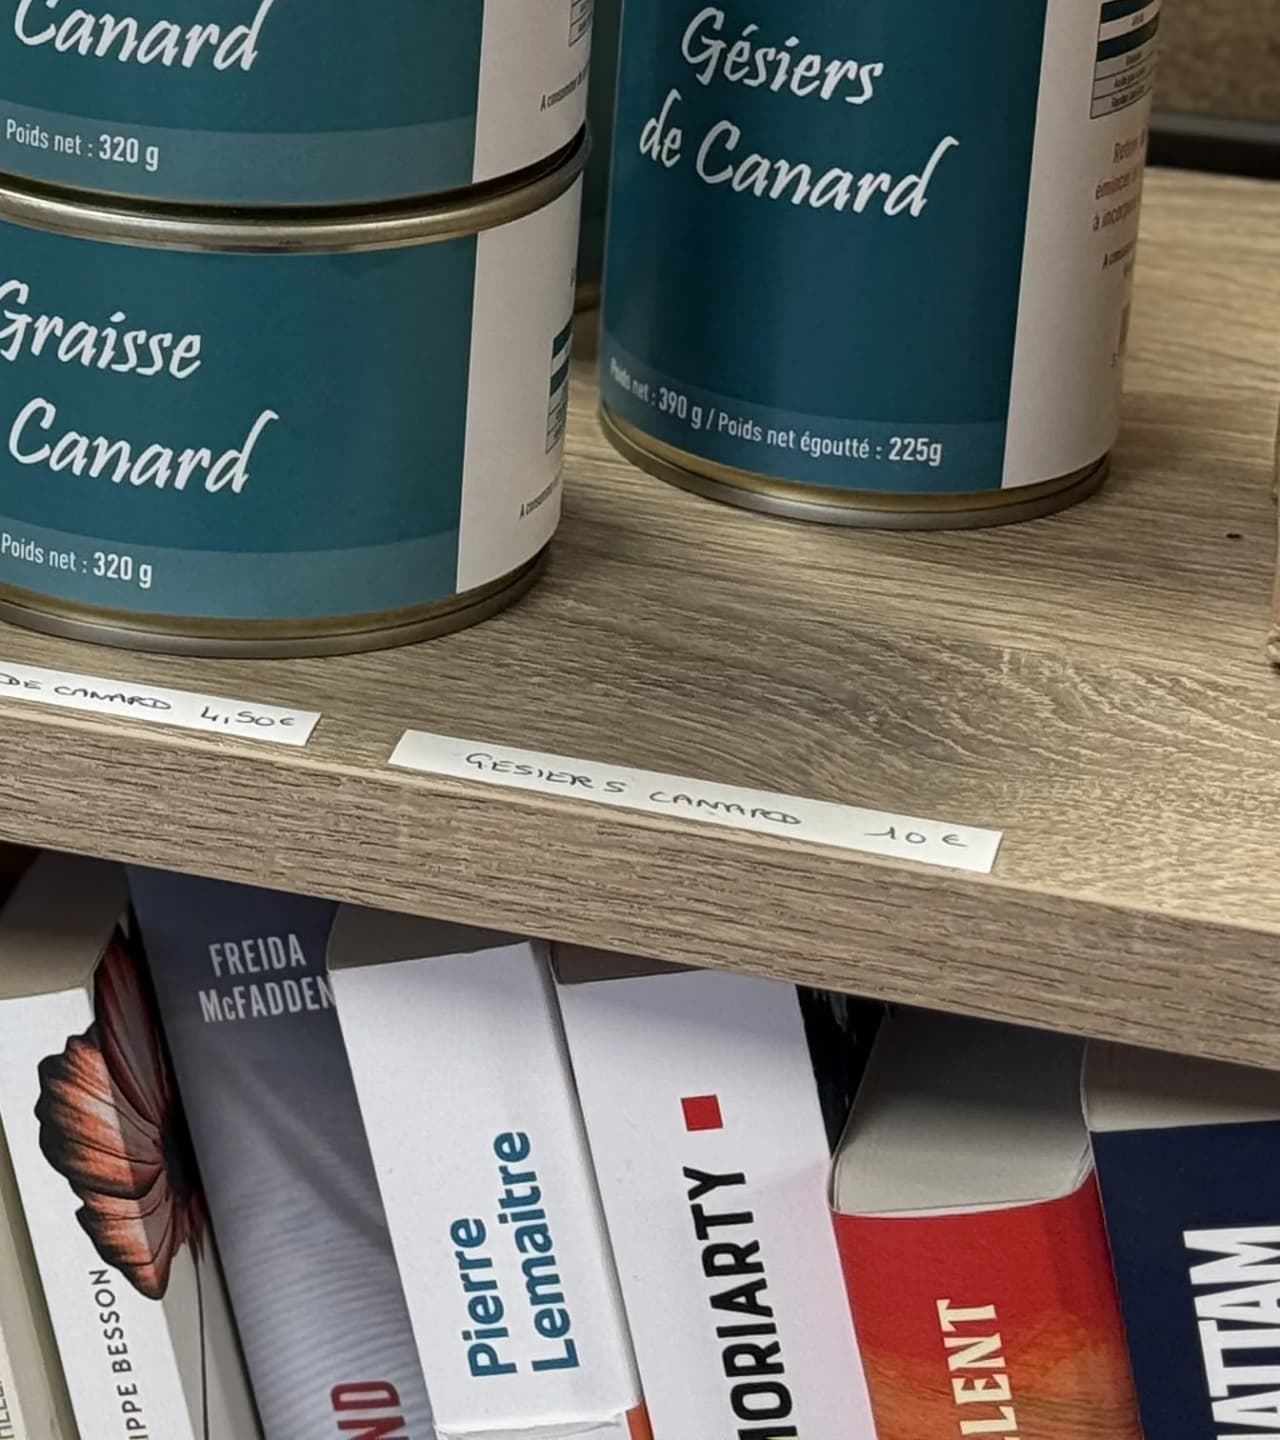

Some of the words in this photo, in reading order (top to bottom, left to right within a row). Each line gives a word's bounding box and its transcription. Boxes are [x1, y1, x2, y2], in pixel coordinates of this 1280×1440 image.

[681, 6, 885, 105] Gésiers
[5, 118, 46, 149] Poids
[48, 132, 83, 159] net
[97, 132, 140, 165] 320
[145, 143, 161, 172] g
[638, 89, 684, 169] de
[696, 119, 960, 218] Canard
[8, 397, 280, 495] Canard
[658, 386, 688, 420] 390
[690, 405, 703, 430] g
[717, 411, 763, 443] Poids
[766, 429, 796, 450] net
[799, 431, 870, 459] égoutté
[0, 532, 45, 564] Poids
[48, 547, 78, 573] net
[92, 548, 134, 582] 320
[137, 560, 153, 590] g
[54, 685, 173, 712] CANARD
[647, 790, 803, 826] CANARD
[198, 973, 337, 1024] McFADDEN
[208, 933, 307, 978] FREIDA
[449, 1216, 519, 1378] Pierre
[492, 1130, 581, 1374] Lemaitre
[89, 1268, 132, 1375] BESSON
[682, 1165, 799, 1440] ORIARTY
[1182, 1224, 1280, 1440] ATTAM
[936, 1298, 1020, 1440] LENT
